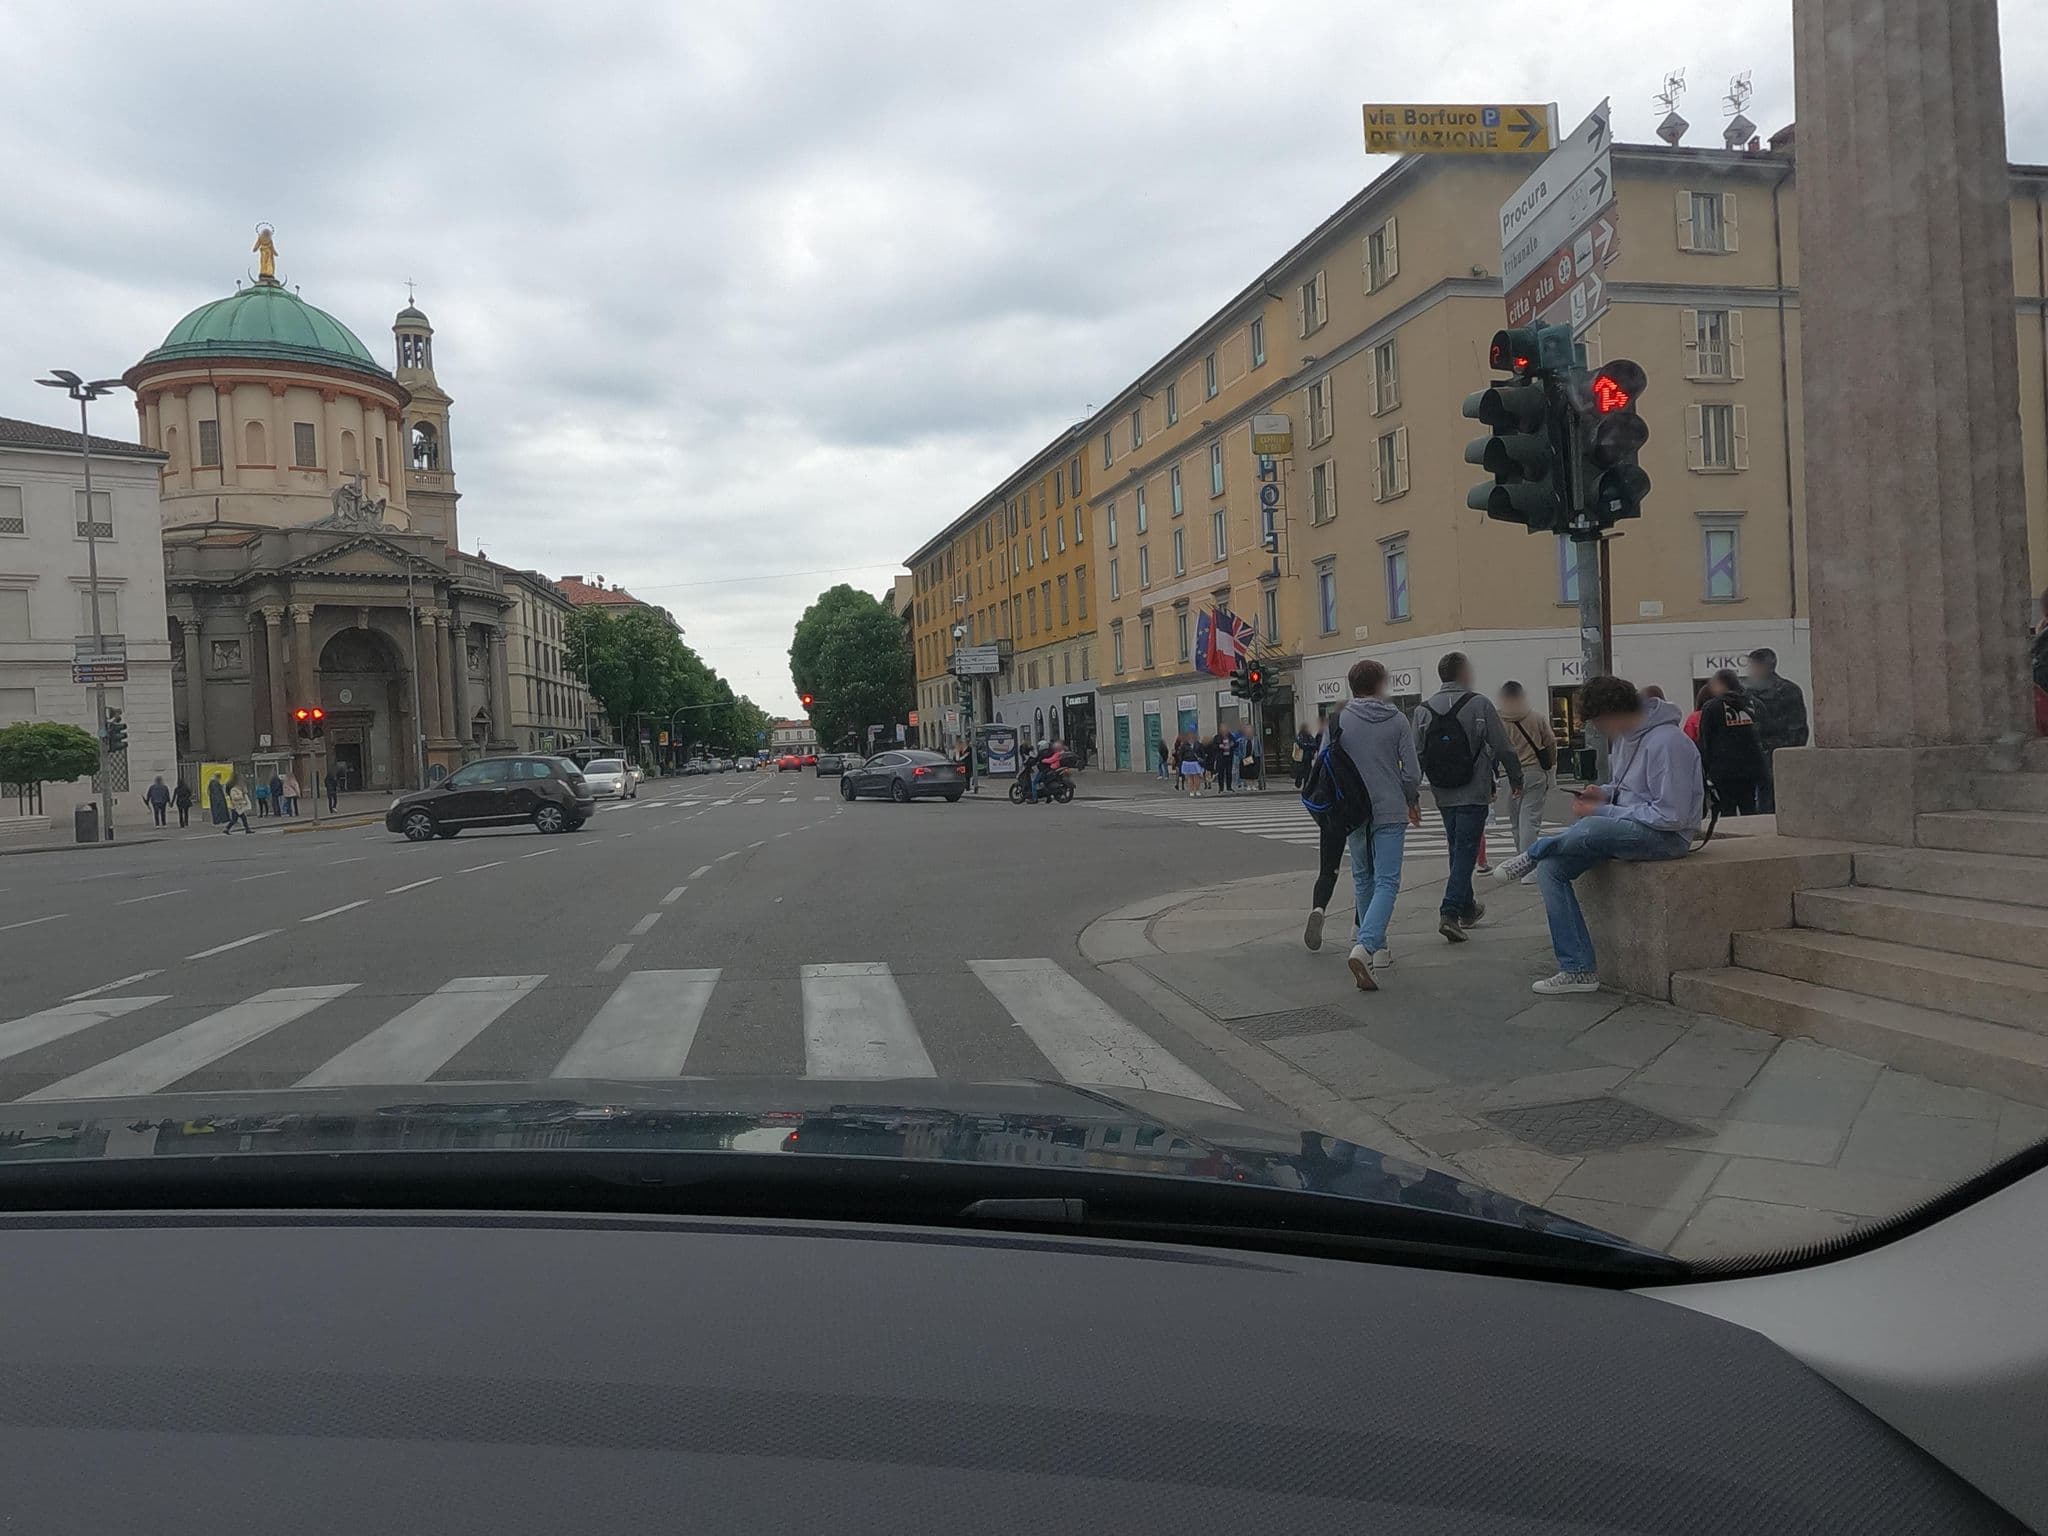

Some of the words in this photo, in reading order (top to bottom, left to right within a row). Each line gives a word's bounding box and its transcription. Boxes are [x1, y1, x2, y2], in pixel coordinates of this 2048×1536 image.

[1369, 109, 1395, 125] via
[1404, 108, 1477, 125] Borfuro
[1485, 109, 1497, 125] P
[1502, 180, 1548, 235] Procura
[1504, 236, 1538, 276] tribunale
[1535, 277, 1554, 304] alta
[1318, 681, 1341, 695] KIKO
[1392, 673, 1412, 688] IKO
